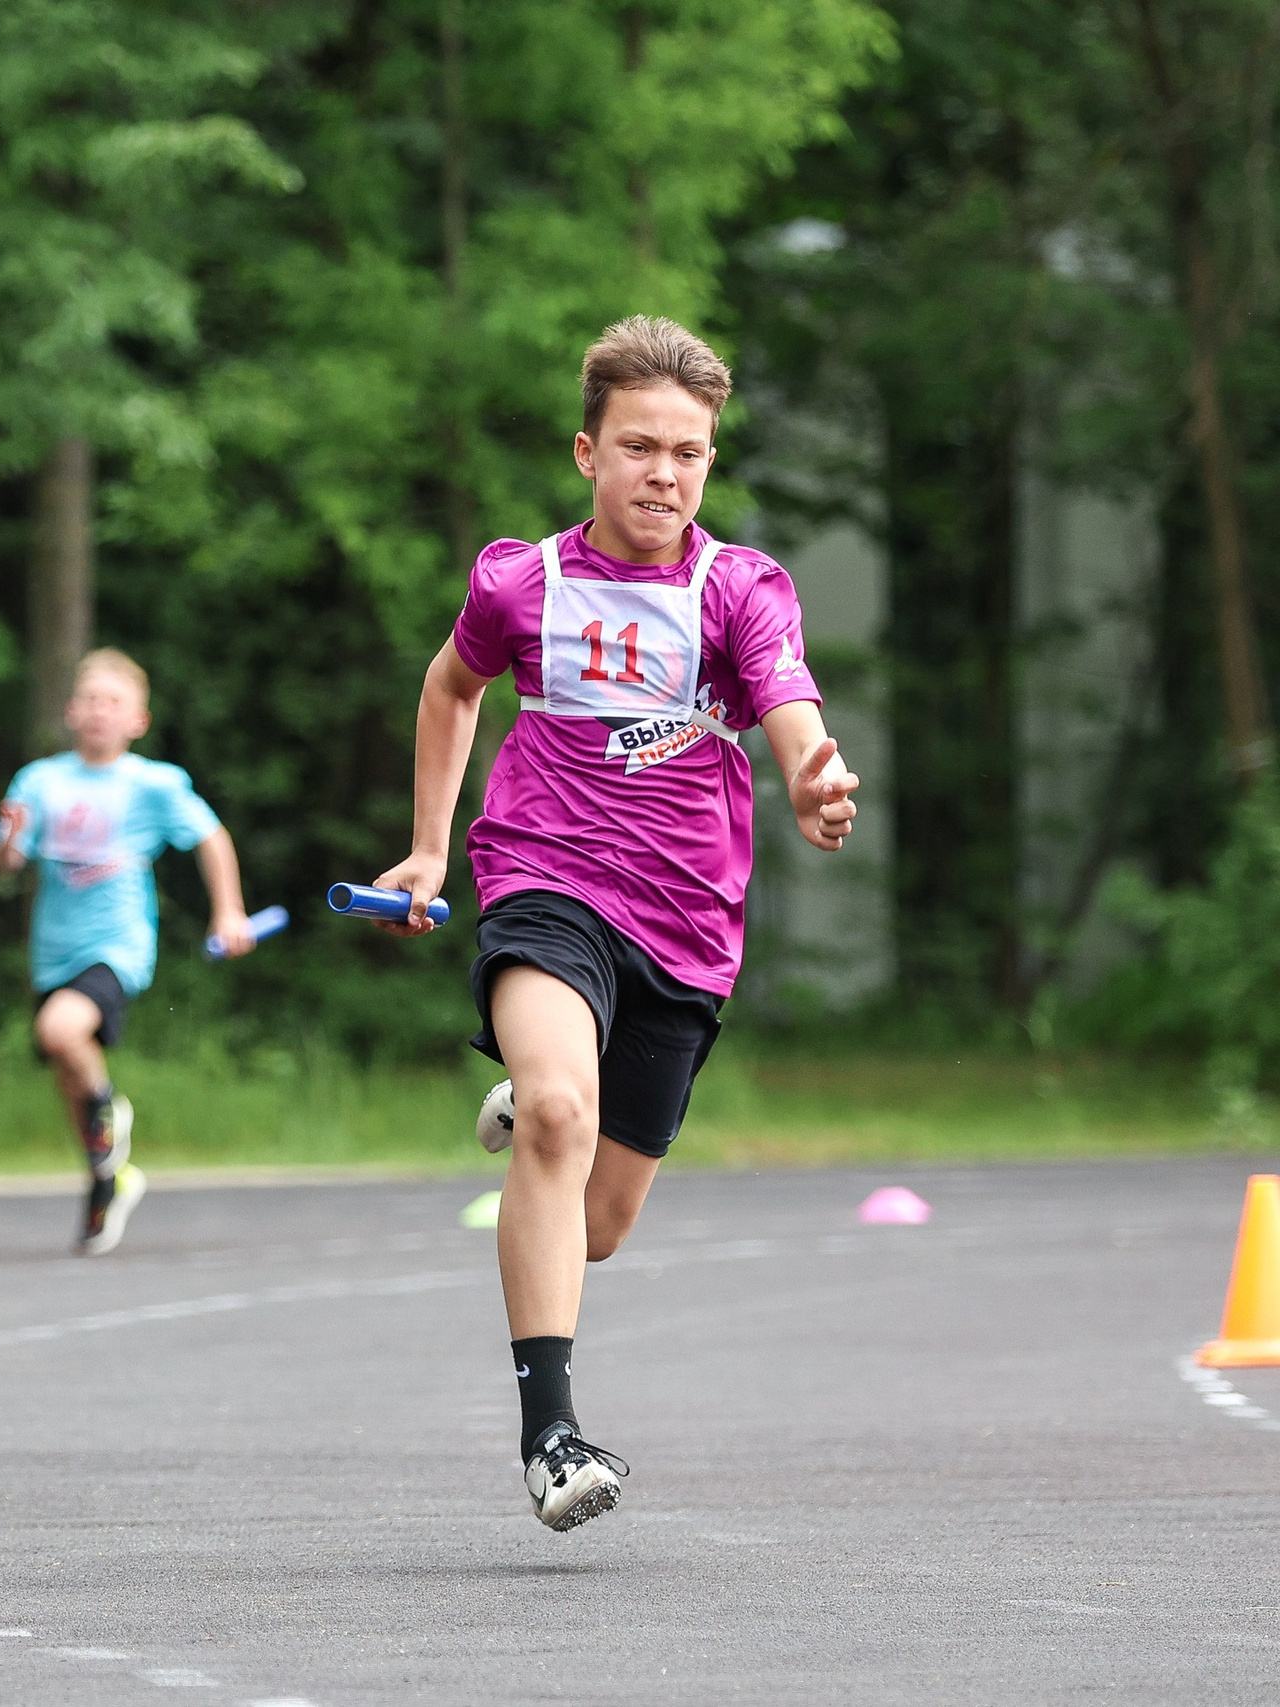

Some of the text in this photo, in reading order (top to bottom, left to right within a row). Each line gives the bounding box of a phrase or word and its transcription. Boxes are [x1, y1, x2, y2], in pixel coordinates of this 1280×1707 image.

[580, 620, 645, 684] 11
[618, 700, 702, 750] ВЫЗ
[544, 1433, 561, 1453] NIKE
